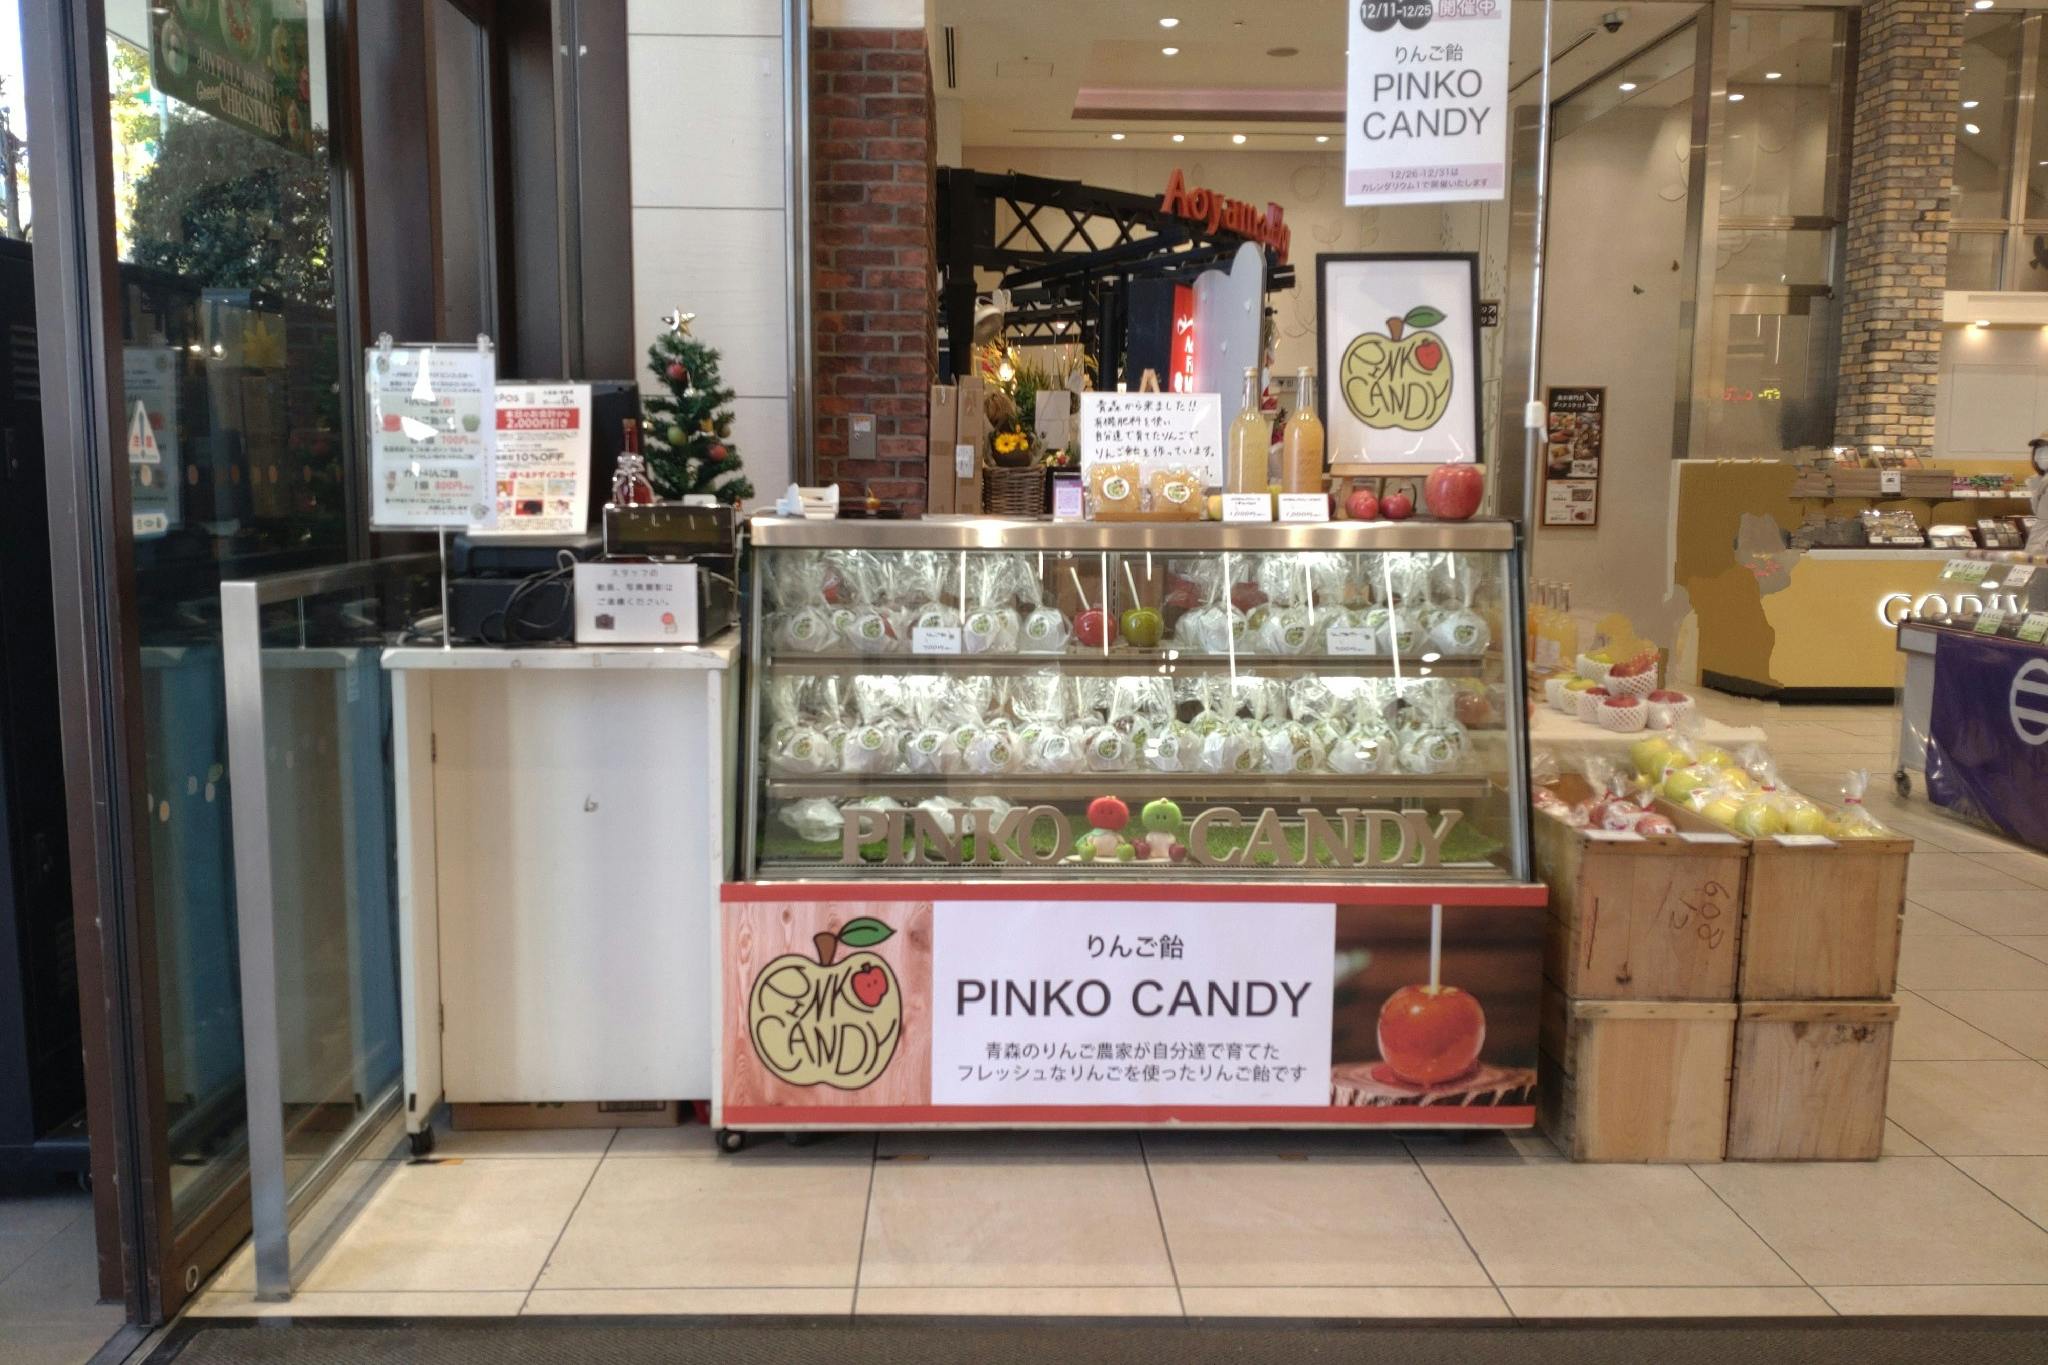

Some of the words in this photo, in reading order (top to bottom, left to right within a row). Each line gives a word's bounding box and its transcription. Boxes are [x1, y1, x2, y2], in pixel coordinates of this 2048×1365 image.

[1439, 0, 1496, 17] 開催中
[1394, 43, 1464, 64] りんご飴
[1373, 69, 1482, 102] PINKO
[1363, 107, 1491, 141] CANDY
[1346, 375, 1449, 420] CANDY
[840, 803, 1073, 867] PINKO
[1189, 804, 1464, 868] CANDY
[1087, 935, 1184, 960] りんご飴
[956, 979, 1112, 1017] PINKO
[1132, 979, 1312, 1017] CANDY
[756, 1016, 897, 1076] CANDY
[985, 1042, 1280, 1060] 青森のりんご農家が自分達で育てた
[958, 1064, 1308, 1083] フレッシュなりんごを使ったりんご飴です
